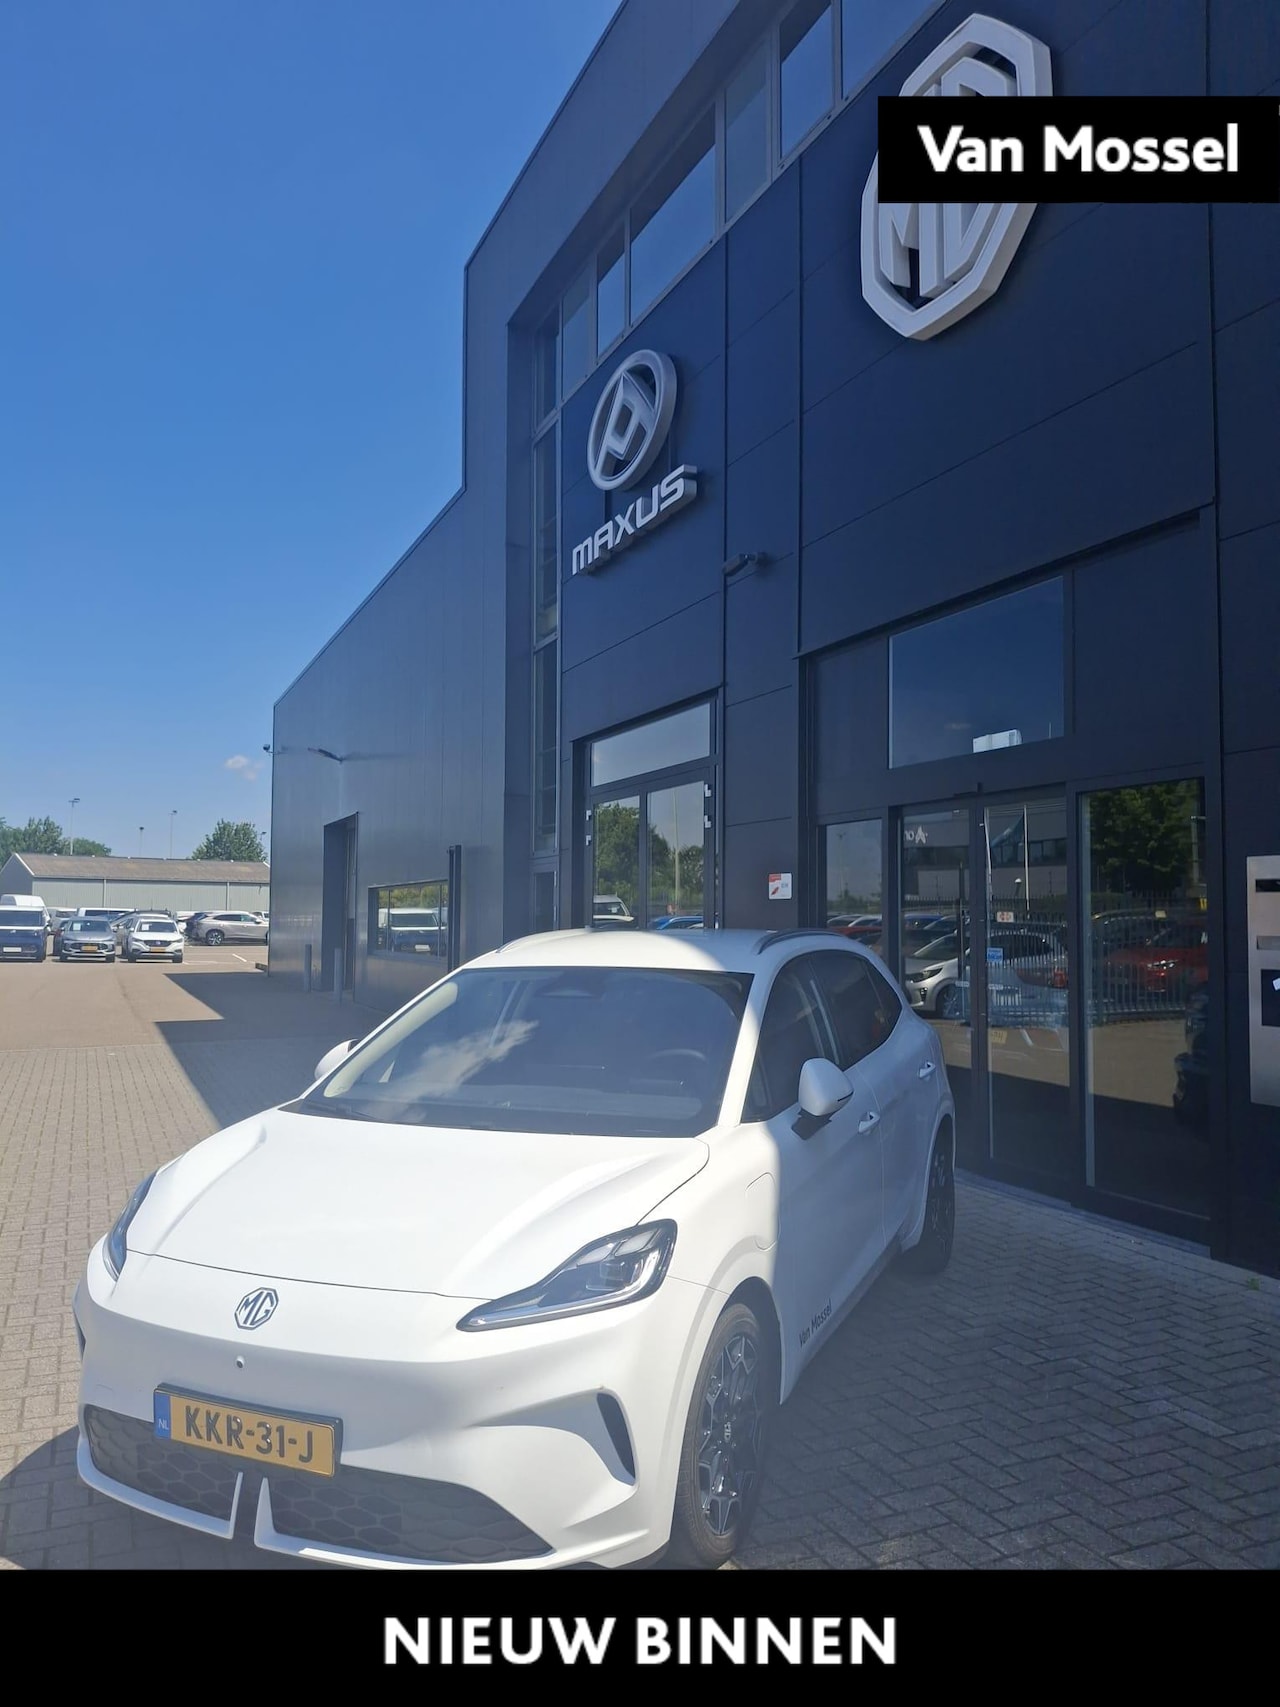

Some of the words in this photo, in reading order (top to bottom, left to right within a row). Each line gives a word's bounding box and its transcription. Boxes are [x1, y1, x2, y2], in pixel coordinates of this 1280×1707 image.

[572, 464, 696, 575] MAXUS
[239, 1290, 275, 1327] MG
[799, 1327, 811, 1348] Van
[811, 1297, 832, 1334] Mossel
[158, 1418, 170, 1431] NL
[185, 1405, 314, 1463] KKR-31-J
